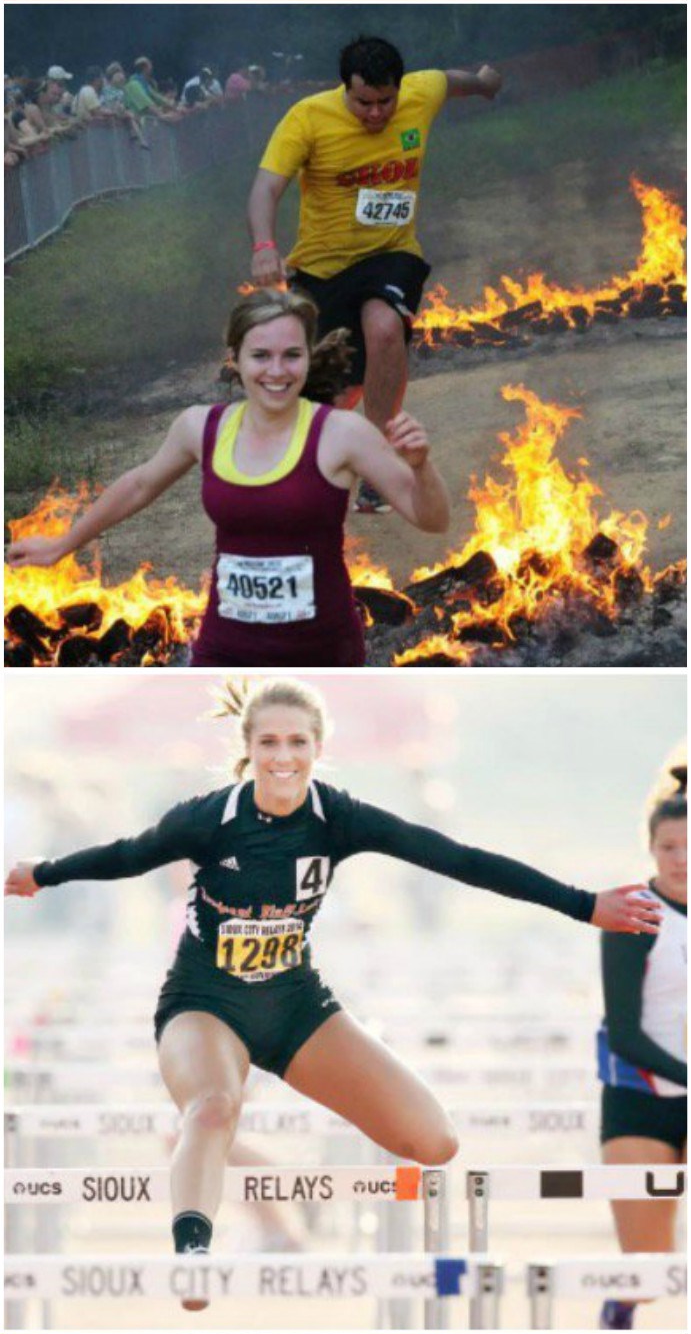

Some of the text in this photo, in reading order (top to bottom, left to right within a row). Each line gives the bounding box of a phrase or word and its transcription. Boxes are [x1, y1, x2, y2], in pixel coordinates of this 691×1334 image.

[362, 201, 410, 220] 42745
[227, 572, 297, 601] 40521
[300, 857, 323, 895] 4
[221, 933, 299, 973] 1298
[82, 1176, 151, 1202] SIOUX
[244, 1175, 334, 1202] RELAYS
[61, 1266, 146, 1298] SIOUX
[169, 1266, 235, 1298] CITY
[259, 1266, 367, 1298] RELAYS
